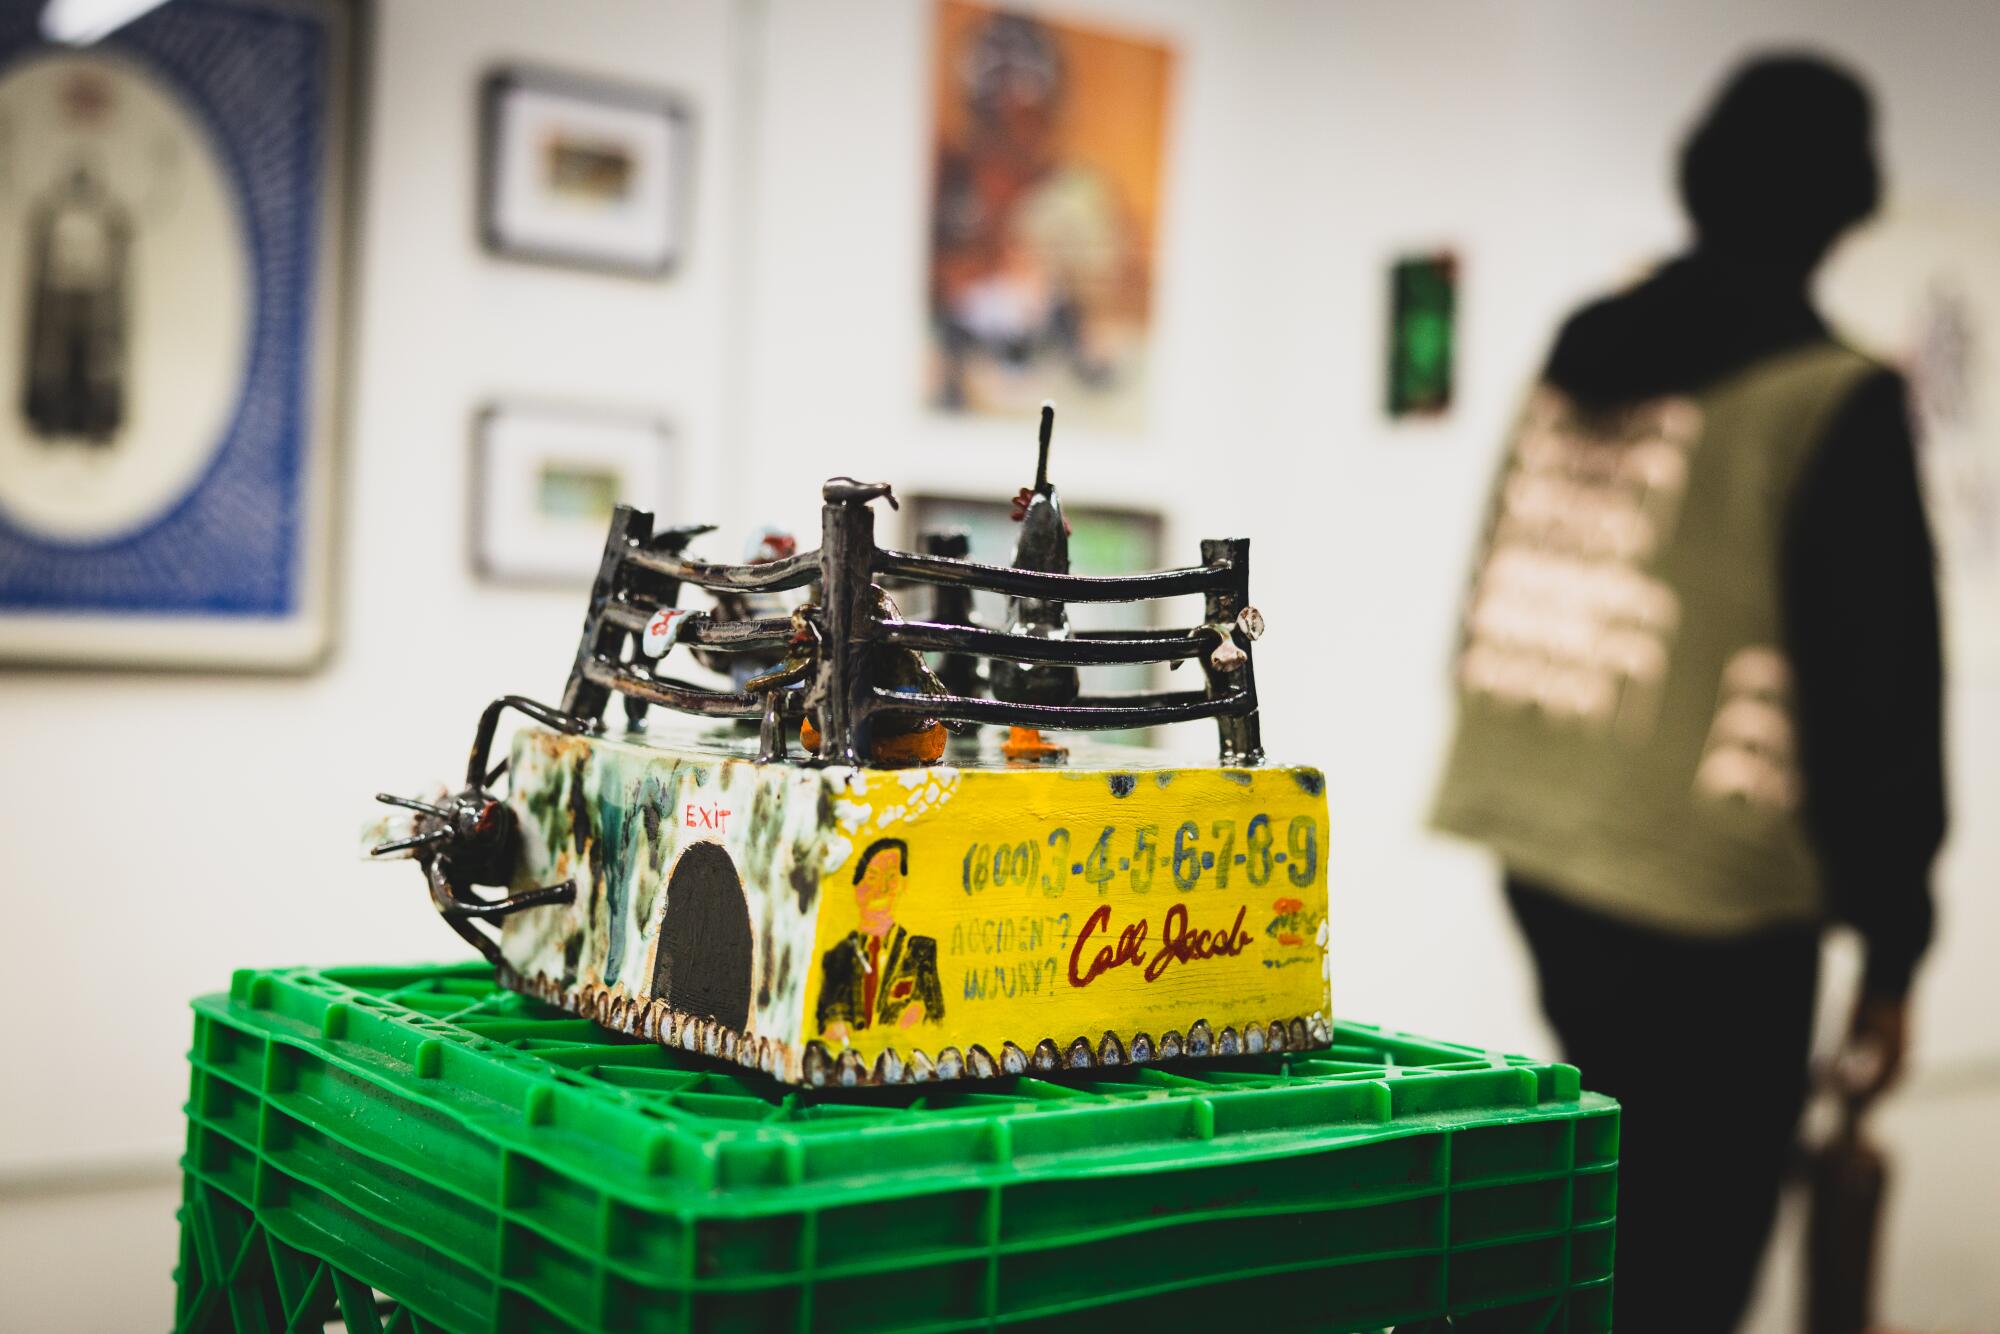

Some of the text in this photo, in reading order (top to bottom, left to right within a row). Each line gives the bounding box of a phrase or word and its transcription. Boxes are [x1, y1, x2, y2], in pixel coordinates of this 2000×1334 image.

[950, 912, 1070, 956] ACCIDENT?
[1068, 904, 1148, 988] Call
[1143, 903, 1254, 983] Jacob
[963, 956, 1058, 1001] INJURY?
